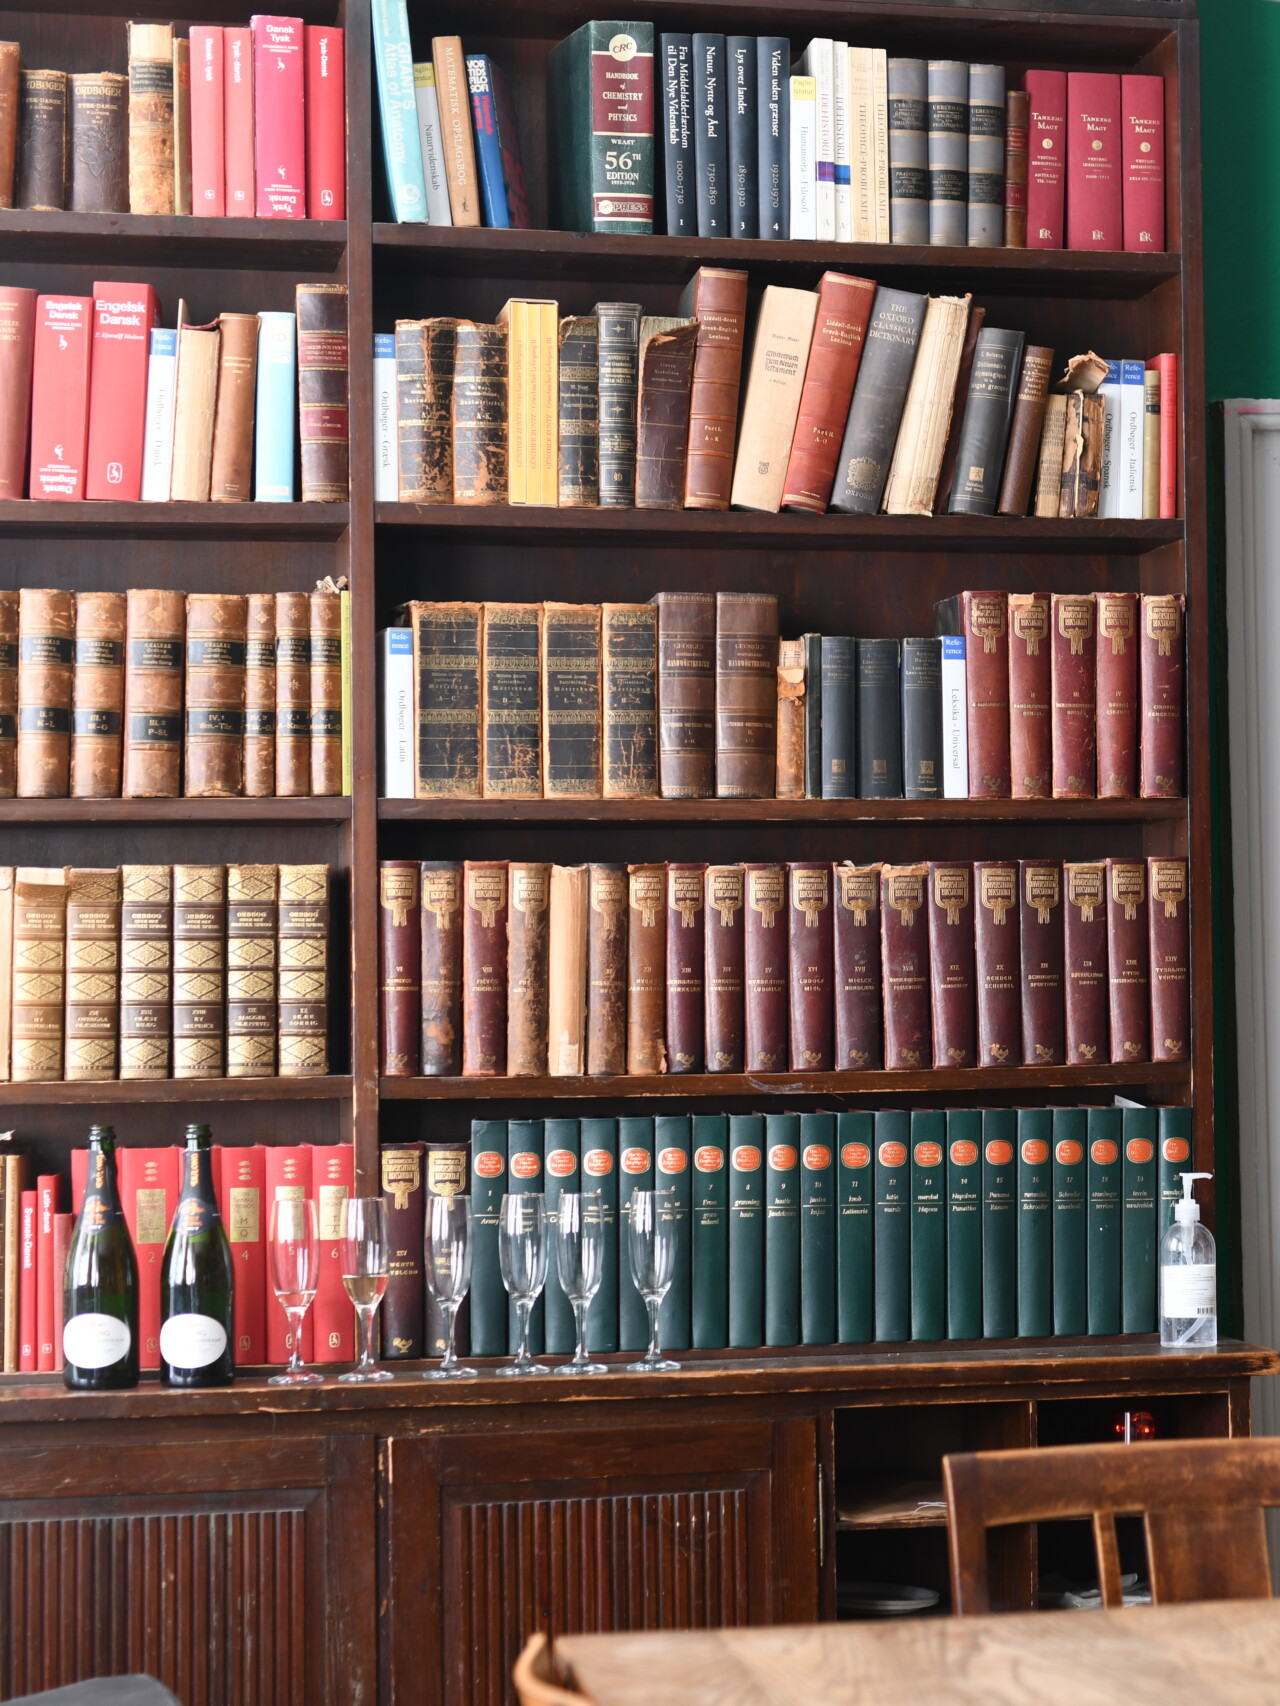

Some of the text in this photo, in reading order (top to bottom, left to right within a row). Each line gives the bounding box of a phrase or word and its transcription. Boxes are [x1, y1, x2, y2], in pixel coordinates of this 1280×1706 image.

[266, 24, 294, 34] Dansk
[270, 34, 290, 43] Tysk
[613, 42, 632, 53] CRC
[384, 42, 398, 78] Atlas
[466, 60, 485, 68] VOR
[398, 42, 415, 110] GRANT'S
[467, 69, 486, 77] TIDS
[606, 72, 639, 80] HANDBOOK
[469, 77, 487, 85] FILO
[735, 49, 747, 115] Lys over landet
[388, 82, 400, 95] of
[470, 84, 489, 93] SOFI
[704, 46, 718, 138] Natur, Nytte og Ånd
[769, 50, 781, 137] Viden uden grænser
[602, 91, 643, 101] CHEMISTRY
[666, 45, 679, 145] til Den Nye Videnskab
[679, 45, 691, 148] Fra Middelalderlærdom
[445, 47, 466, 186] MATEMATISK OPSLAGSBOG
[608, 113, 637, 122] PHYSICS
[390, 100, 406, 163] Anatomy
[821, 93, 830, 158] IDEHISTORIE
[836, 97, 845, 161] IDEHISTORIE
[425, 124, 440, 191] Naturvidenskab
[800, 126, 809, 213] Humaniora Filosofi
[606, 171, 639, 181] EDITION
[676, 160, 685, 204] 1000-1730
[709, 163, 718, 205] 1730-1850
[738, 165, 747, 208] 1850-1920
[269, 195, 296, 203] Dansk
[272, 203, 293, 212] Tysk
[614, 203, 648, 212] PRESS
[740, 222, 745, 230] 3
[773, 222, 779, 231] 4
[46, 300, 82, 311] Engelsk
[96, 300, 146, 314] Engelsk
[890, 303, 908, 313] THE
[49, 311, 78, 320] Dansk
[100, 313, 140, 326] Dansk
[879, 312, 914, 325] OXFORD
[873, 321, 917, 336] CLASSICAL
[830, 336, 852, 347] Lexicon
[869, 330, 916, 346] DICTIONARY
[381, 391, 391, 469] Ordbøger Græsk
[1103, 413, 1113, 489] Ordbøger Spansk
[1128, 411, 1138, 493] Ordbøger Italiensk
[40, 474, 77, 485] Engelsk
[43, 484, 72, 494] Dansk
[845, 489, 873, 500] OXFORD
[945, 638, 962, 646] Refe-
[951, 688, 960, 769] Leksika Universal
[23, 1207, 33, 1269] Svensk-Dansk
[147, 1251, 156, 1263] 2
[241, 1249, 249, 1261] 4
[331, 1248, 339, 1259] 6
